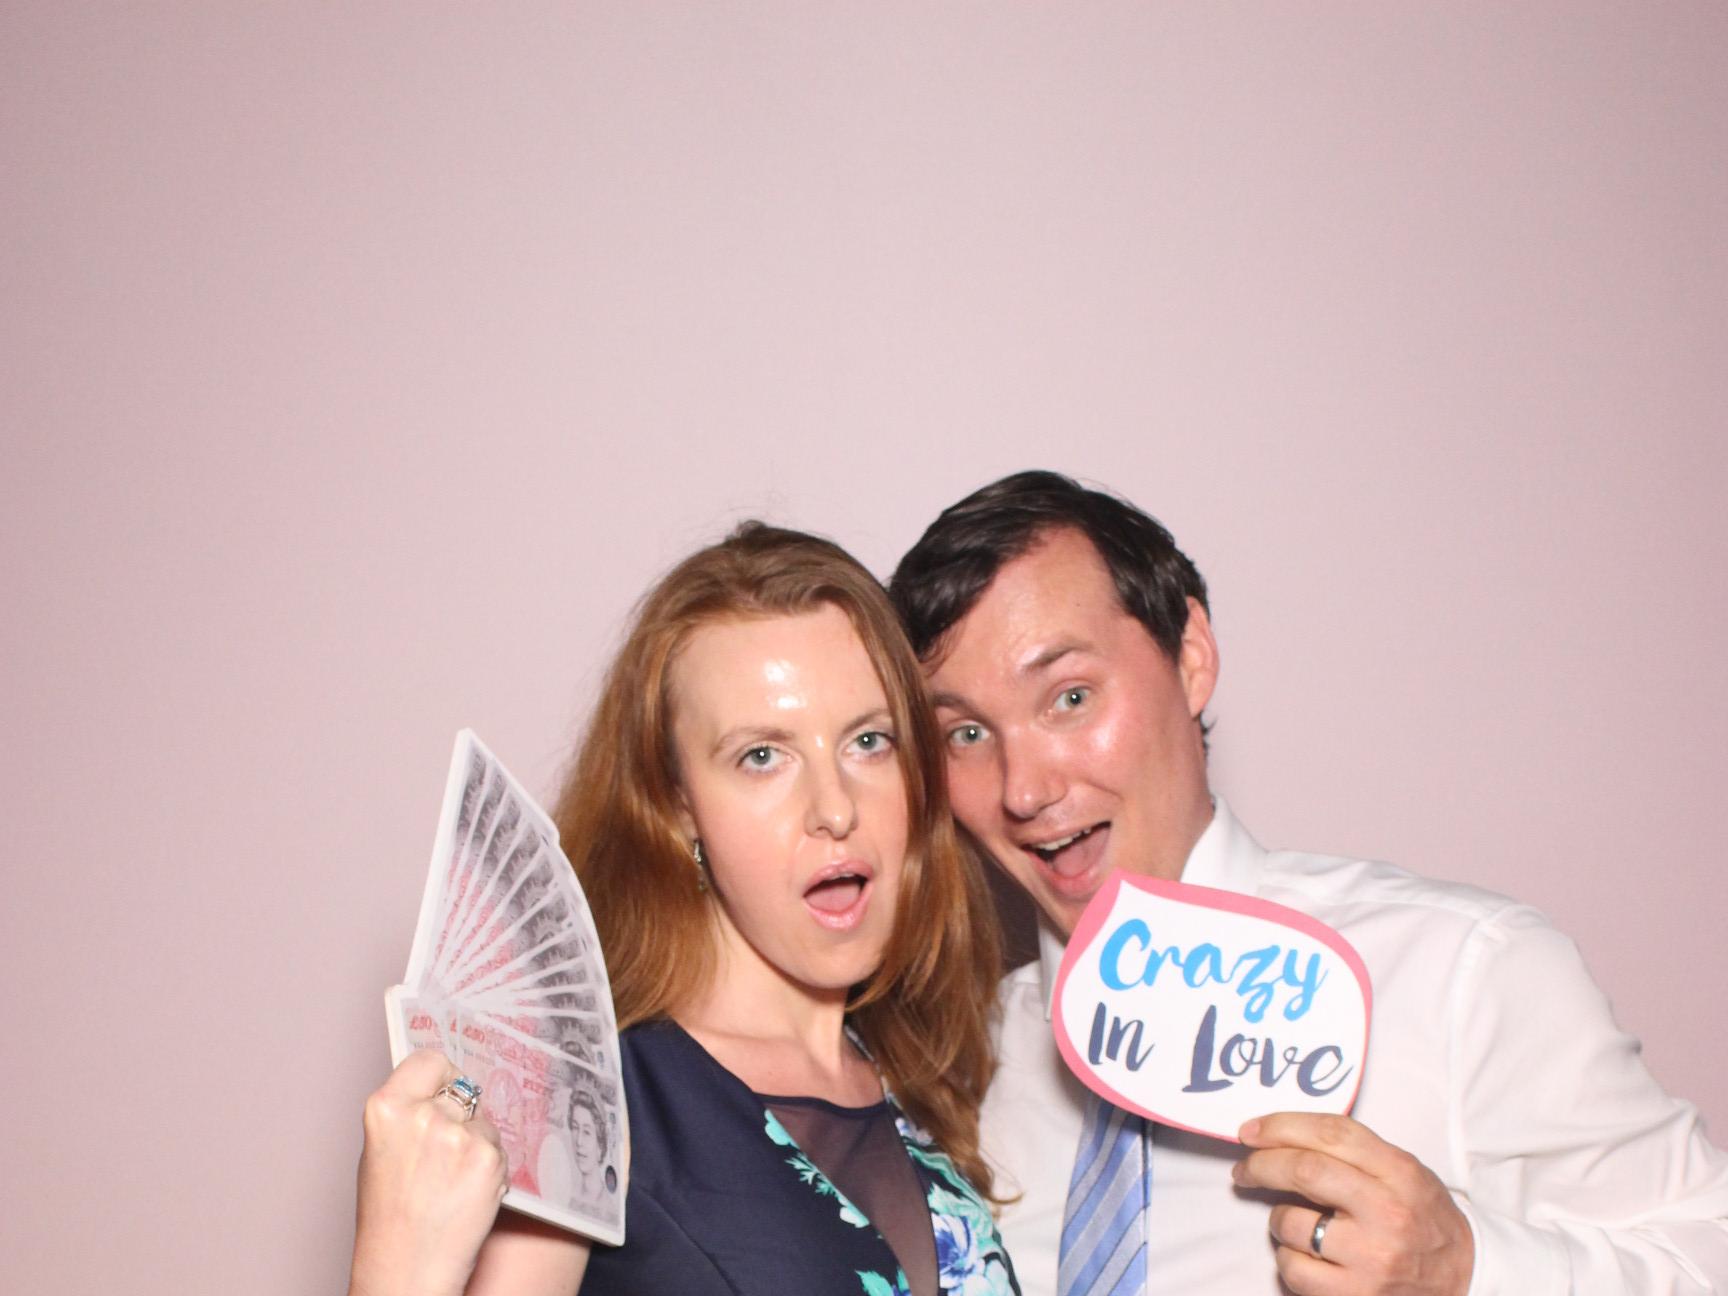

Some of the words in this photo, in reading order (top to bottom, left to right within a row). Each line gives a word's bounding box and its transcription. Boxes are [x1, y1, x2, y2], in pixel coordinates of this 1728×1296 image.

[1099, 918, 1329, 1024] Crazy
[1088, 1001, 1155, 1072] In
[1182, 1004, 1354, 1097] Love
